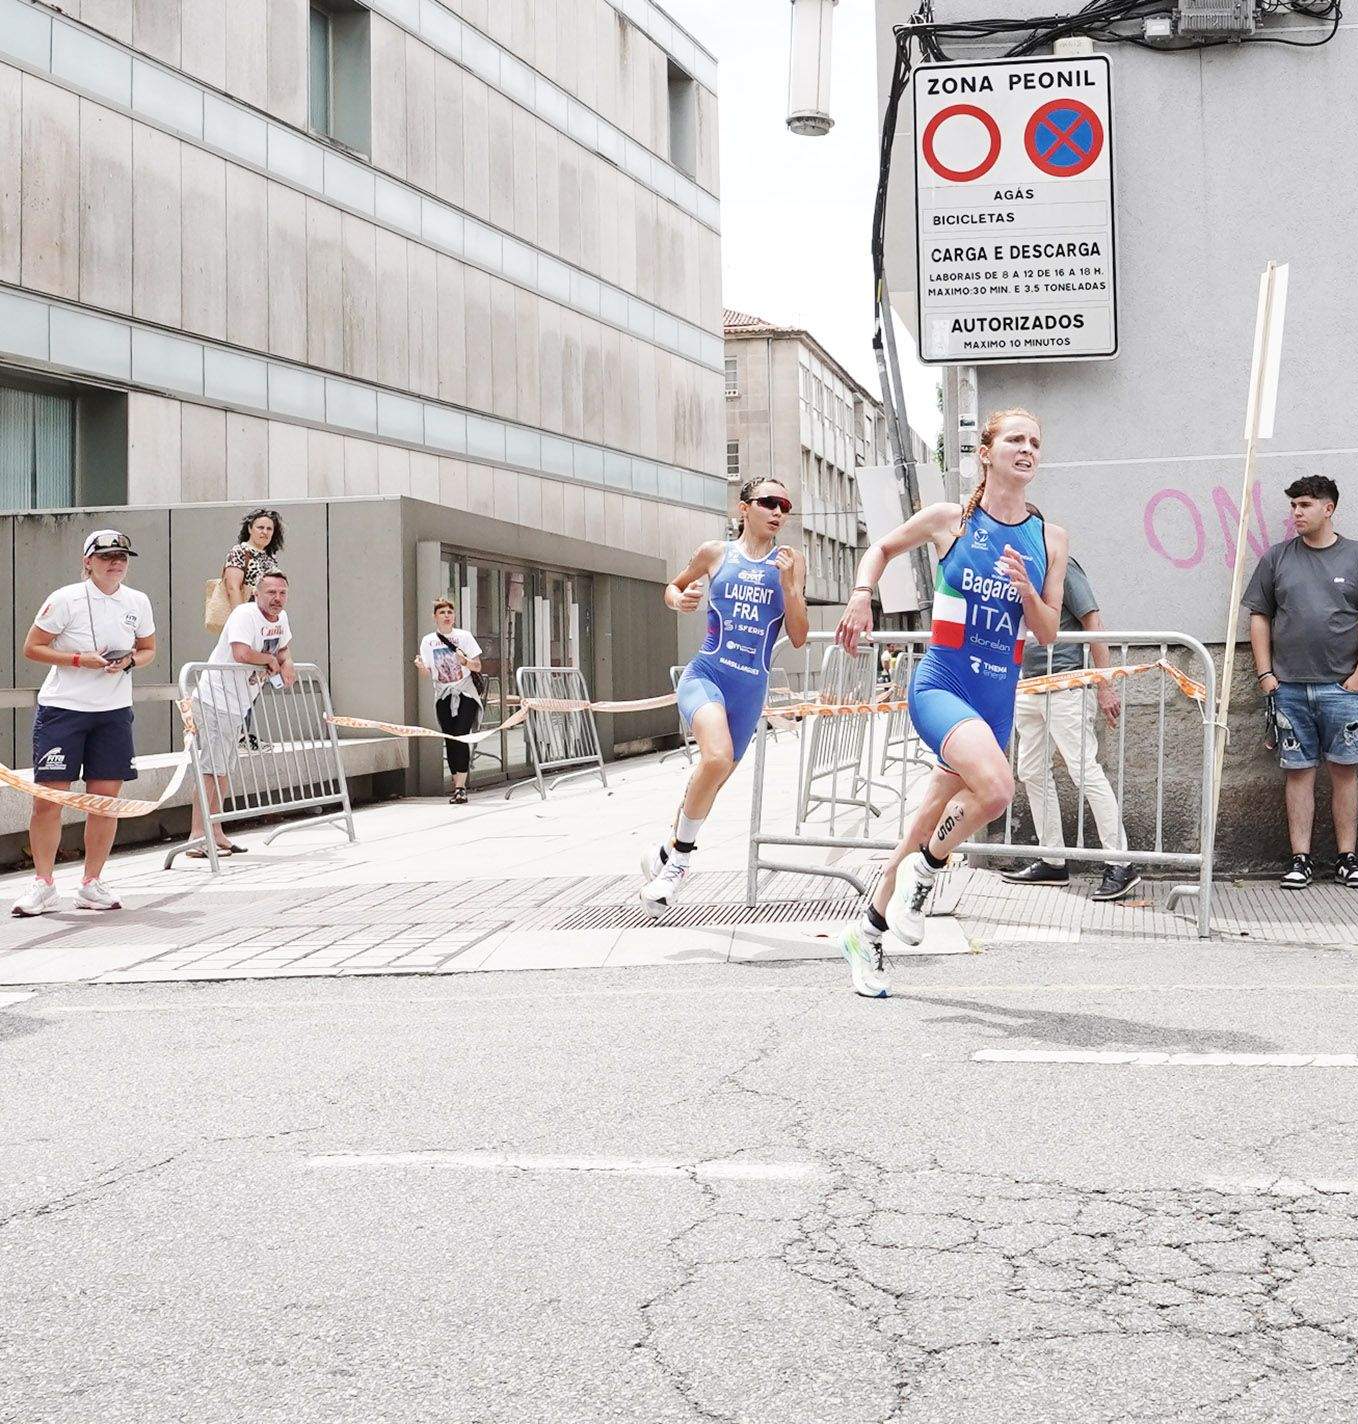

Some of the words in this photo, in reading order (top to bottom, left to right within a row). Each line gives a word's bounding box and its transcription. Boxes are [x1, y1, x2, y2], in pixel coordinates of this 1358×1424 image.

[927, 76, 994, 95] ZONA
[1008, 70, 1096, 91] PEONIL
[993, 186, 1034, 200] AGÁS
[933, 212, 1015, 225] BICICLETAS
[931, 247, 988, 262] CARGA
[995, 246, 1004, 260] E
[1010, 242, 1101, 259] DESCARGA
[929, 272, 981, 282] LABORAIS
[985, 271, 998, 280] DE
[1002, 271, 1009, 279] 8
[1012, 270, 1020, 278] A
[1024, 270, 1034, 278] 12
[1037, 269, 1051, 277] DE
[1055, 268, 1065, 277] 16
[1068, 268, 1076, 276] A
[1080, 268, 1091, 276] 18
[989, 286, 1011, 295] MIN.
[1015, 285, 1020, 293] E
[1024, 284, 1040, 293] 3.5
[1044, 282, 1106, 292] TONELADAS
[951, 314, 1085, 333] AUTORIZADOS
[964, 339, 1006, 349] MAXIMO
[1010, 339, 1021, 347] 10
[1024, 337, 1071, 347] MINUTOS
[724, 583, 774, 605] LAURENT
[732, 602, 759, 621] FRA
[972, 604, 1013, 636] ITA
